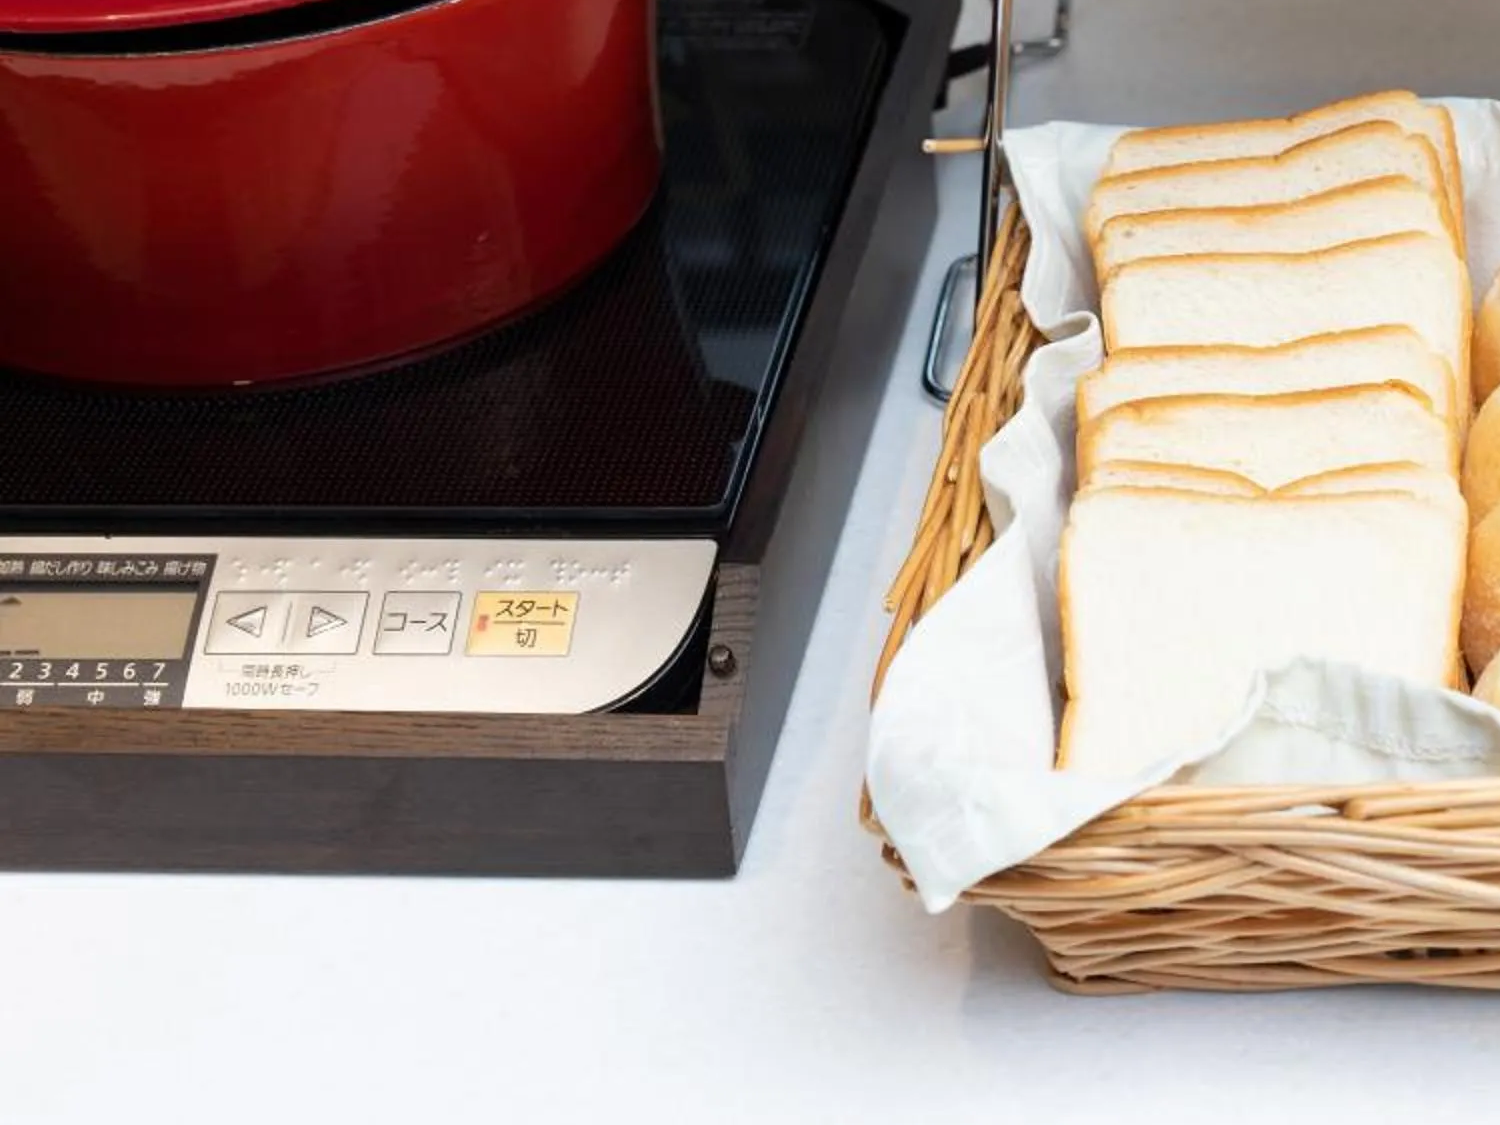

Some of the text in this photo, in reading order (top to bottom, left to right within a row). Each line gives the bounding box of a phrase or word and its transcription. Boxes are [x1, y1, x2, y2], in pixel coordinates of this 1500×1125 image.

[494, 599, 569, 619] スタート
[383, 612, 448, 632] コース
[515, 627, 538, 649] 切
[8, 662, 166, 680] 2 3 4 5 6 7
[86, 688, 105, 706] 中
